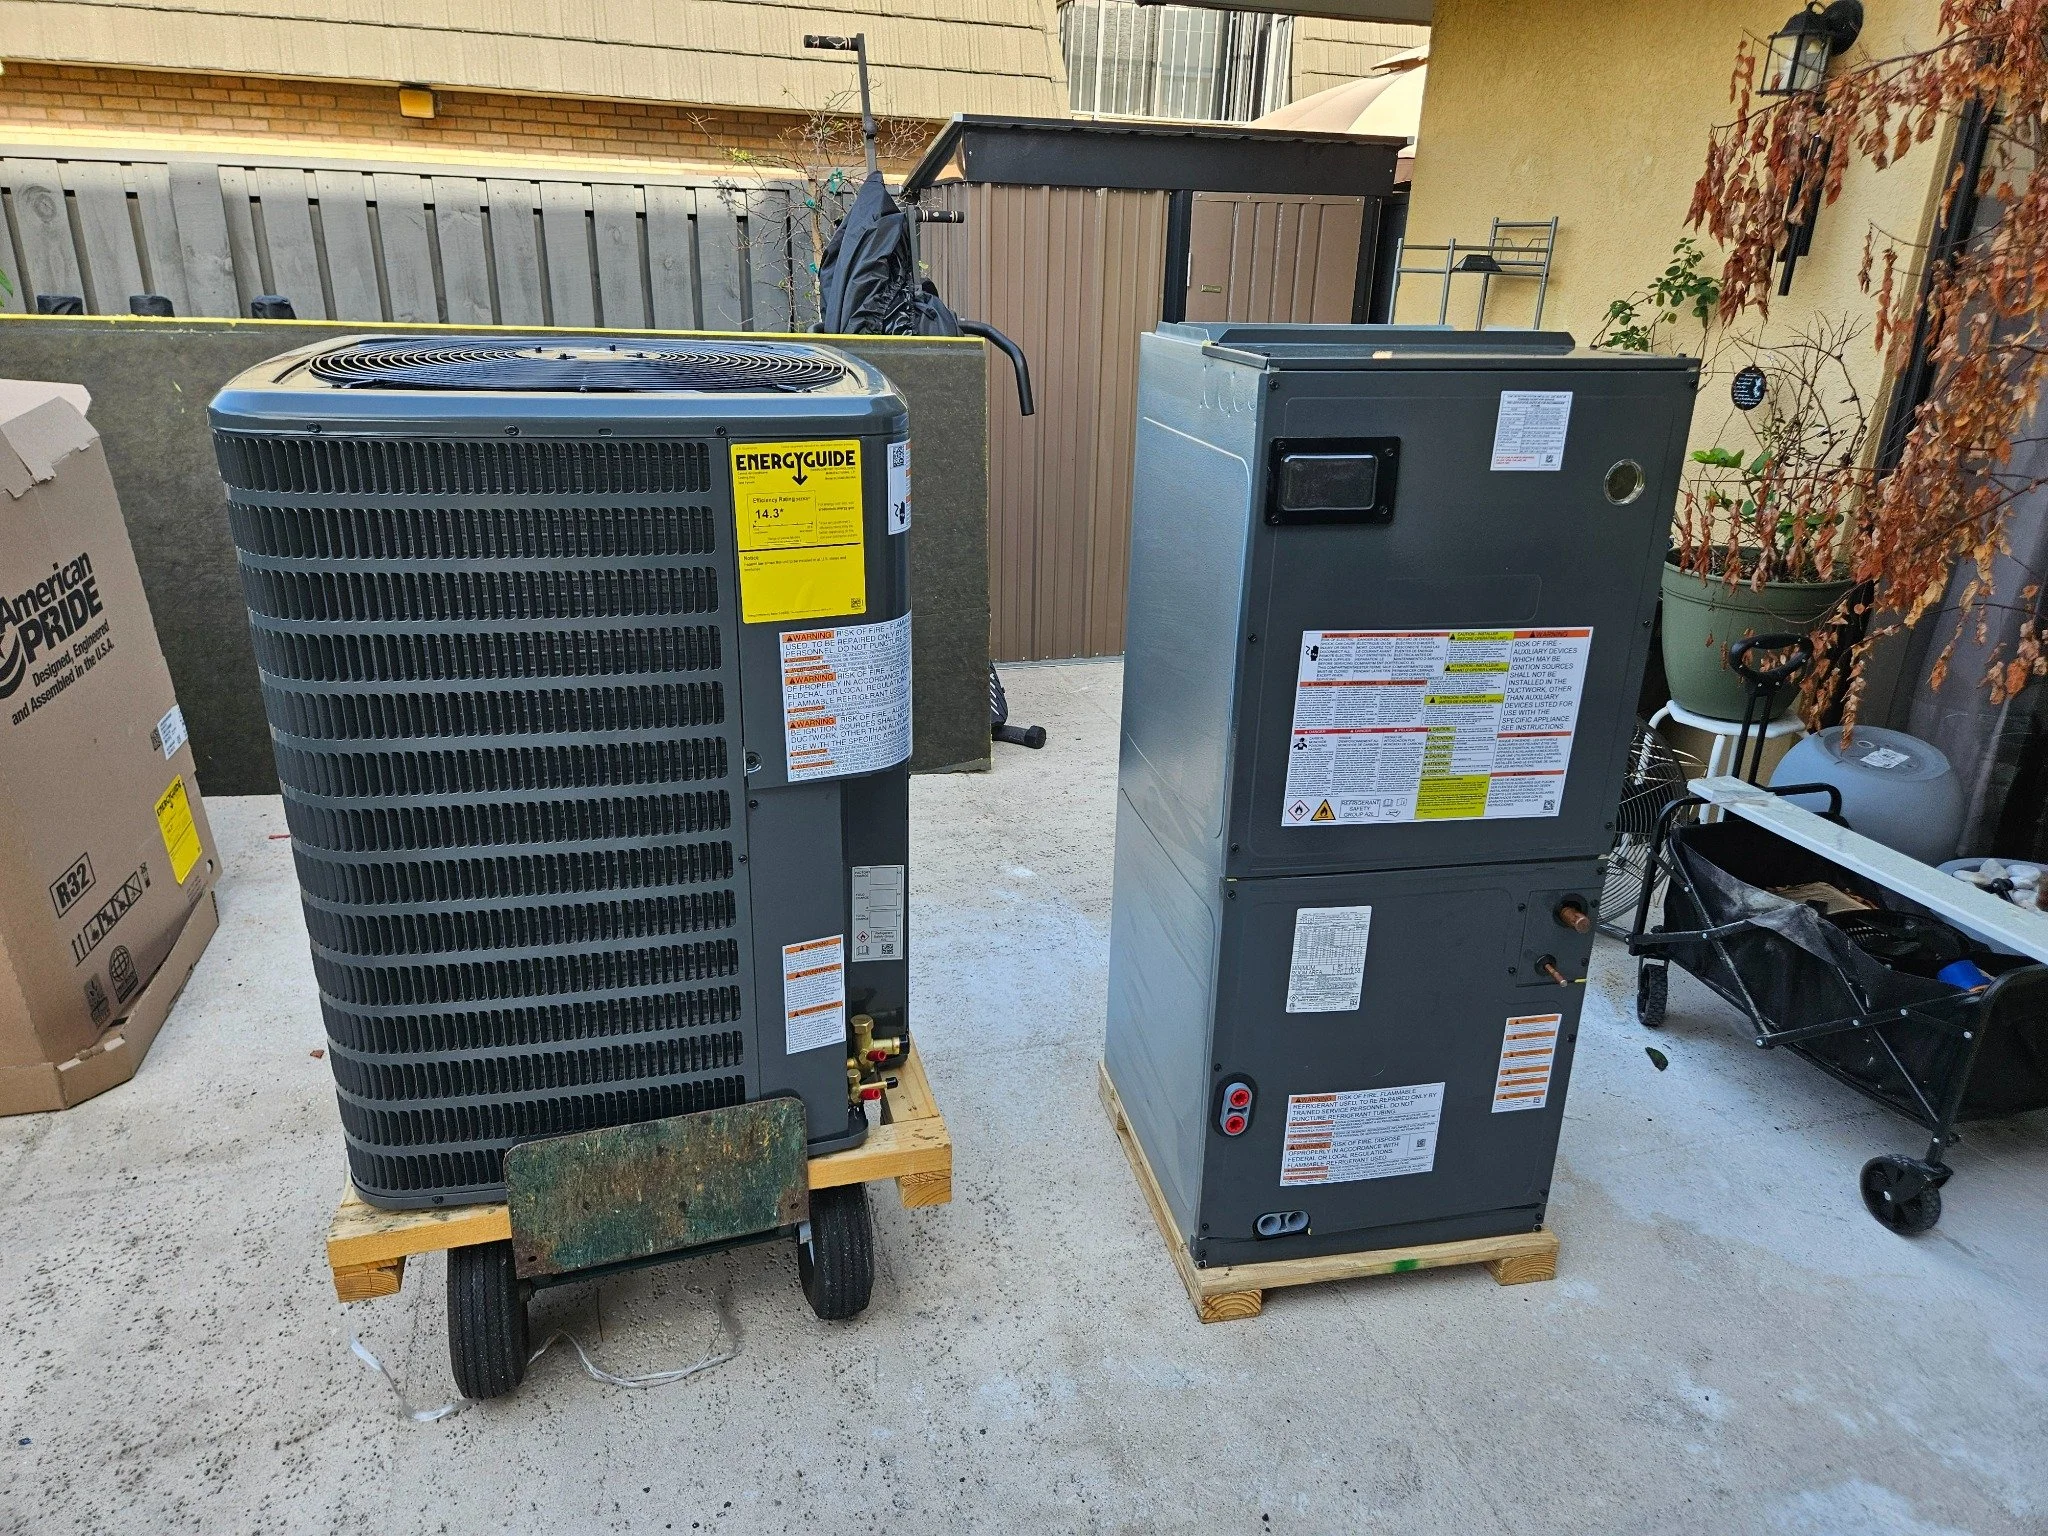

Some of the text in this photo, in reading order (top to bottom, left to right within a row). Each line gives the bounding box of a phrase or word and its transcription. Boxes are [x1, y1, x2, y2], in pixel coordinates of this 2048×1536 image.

[736, 450, 856, 472] ENERGYGUIDE
[0, 551, 94, 634] American
[18, 575, 104, 664] PRIDE
[793, 631, 832, 641] WARNING
[856, 628, 866, 636] OF
[868, 625, 885, 634] FIRE
[1536, 630, 1568, 638] WARNING
[812, 640, 823, 648] TO
[824, 639, 835, 647] BE
[837, 635, 876, 646] REPAIRED
[851, 643, 867, 651] NOT
[1514, 640, 1531, 648] RISK
[1542, 639, 1558, 647] FIRE
[32, 618, 111, 687] Designed, Engineered
[1548, 647, 1578, 655] DEVICES
[1511, 662, 1574, 671] IGNITION SOURCES
[796, 673, 834, 684] WARNING
[837, 671, 856, 680] RISK
[856, 670, 867, 678] OF
[1509, 671, 1531, 679] SHALL
[1547, 670, 1557, 678] BE
[11, 637, 115, 726] and Assembled in the U.S.A.
[787, 685, 798, 693] OF
[799, 681, 842, 692] PROPERLY
[1508, 678, 1545, 686] INSTALLED
[787, 690, 824, 701] FEDERAL
[826, 688, 838, 696] OR
[1548, 685, 1573, 693] OTHER
[1524, 693, 1560, 701] AUXILIARY
[788, 698, 835, 708] FLAMMABLE
[1504, 701, 1534, 709] DEVICES
[796, 717, 835, 728] WARNING
[840, 715, 858, 724] RISK
[859, 713, 870, 721] OF
[1501, 716, 1533, 724] SPECIFIC
[790, 729, 802, 737] BE
[803, 725, 838, 735] IGNITION
[840, 720, 876, 731] SOURCES
[840, 729, 867, 738] OTHER
[867, 725, 887, 734] THAN
[1500, 724, 1515, 732] SEE
[791, 743, 808, 752] USE
[809, 741, 830, 749] WITH
[831, 738, 847, 746] THE
[848, 733, 882, 745] SPECIFIC
[56, 862, 90, 909] R32
[1299, 1095, 1332, 1103] WARNING
[1380, 1088, 1417, 1097] FLAMMABLE
[1292, 1101, 1339, 1110] REFRIGERANT
[1379, 1095, 1410, 1103] REPAIRED
[1291, 1114, 1327, 1122] PUNCTURE
[1327, 1111, 1372, 1120] REFRIGERANT
[1321, 1107, 1349, 1115] SERVICE
[1296, 1142, 1326, 1150] WARNING
[1332, 1140, 1347, 1148] RISK
[1374, 1135, 1401, 1144] DISPOSE
[1339, 1143, 1383, 1153] ACCORDANCE
[1325, 1157, 1370, 1166] REFRIGERANT
[1328, 1152, 1349, 1160] LOCAL
